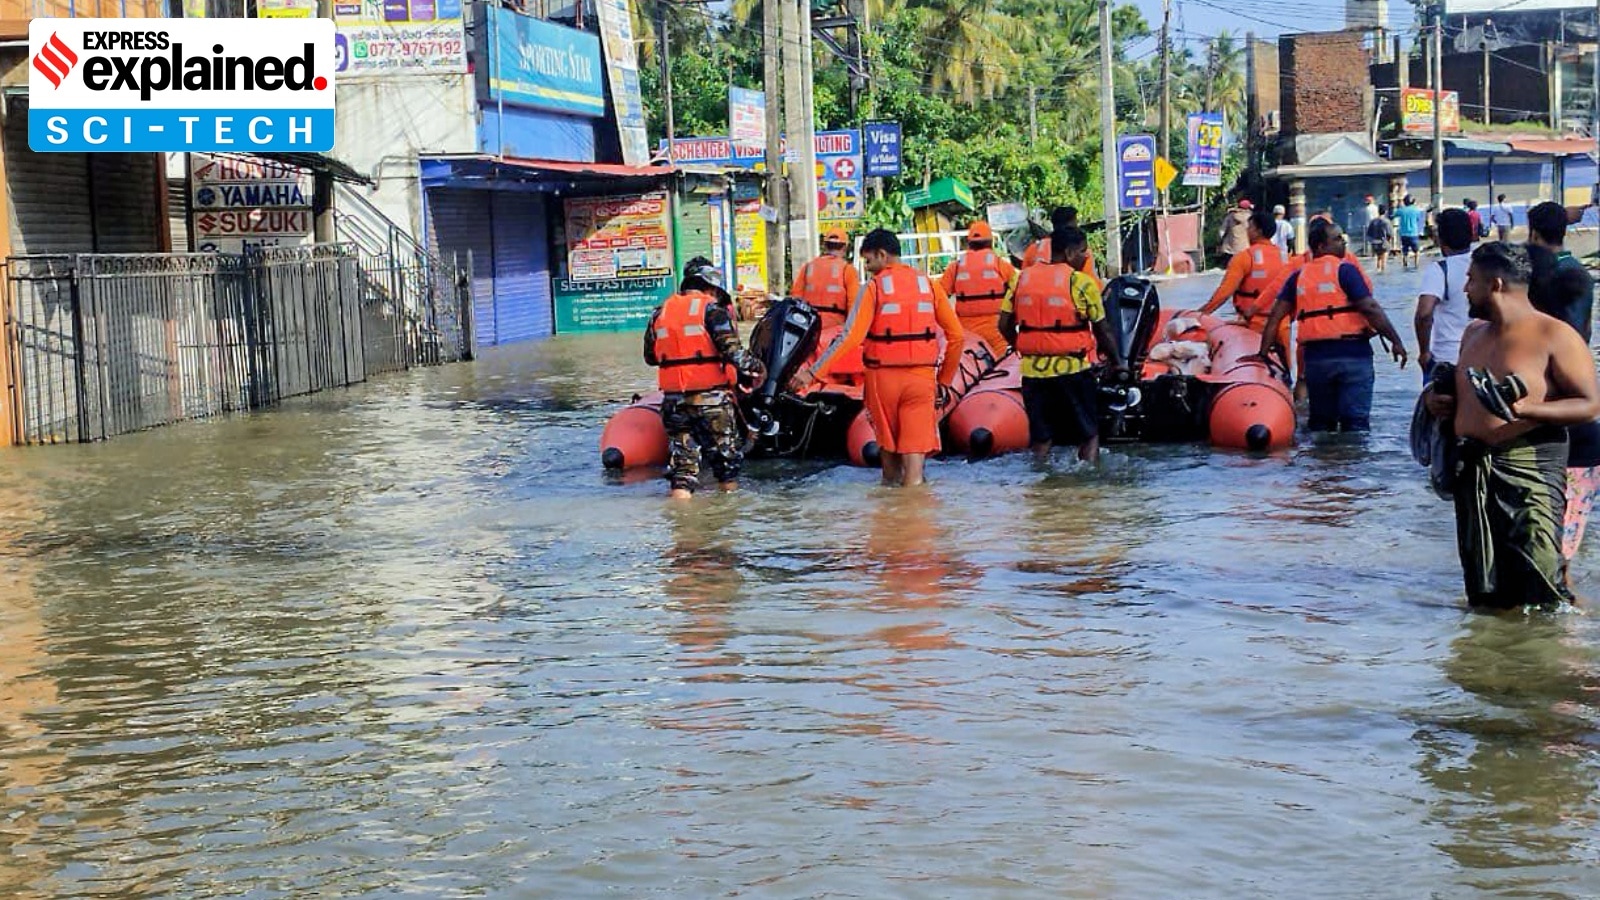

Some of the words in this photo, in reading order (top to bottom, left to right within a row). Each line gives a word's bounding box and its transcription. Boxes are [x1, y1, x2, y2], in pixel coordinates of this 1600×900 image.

[870, 130, 897, 145] Visa
[673, 141, 730, 160] SCHENGEN
[735, 144, 764, 158] VISA
[219, 157, 303, 180] HONDA
[220, 185, 305, 206] YAMAHA
[220, 212, 307, 233] SUZUKI
